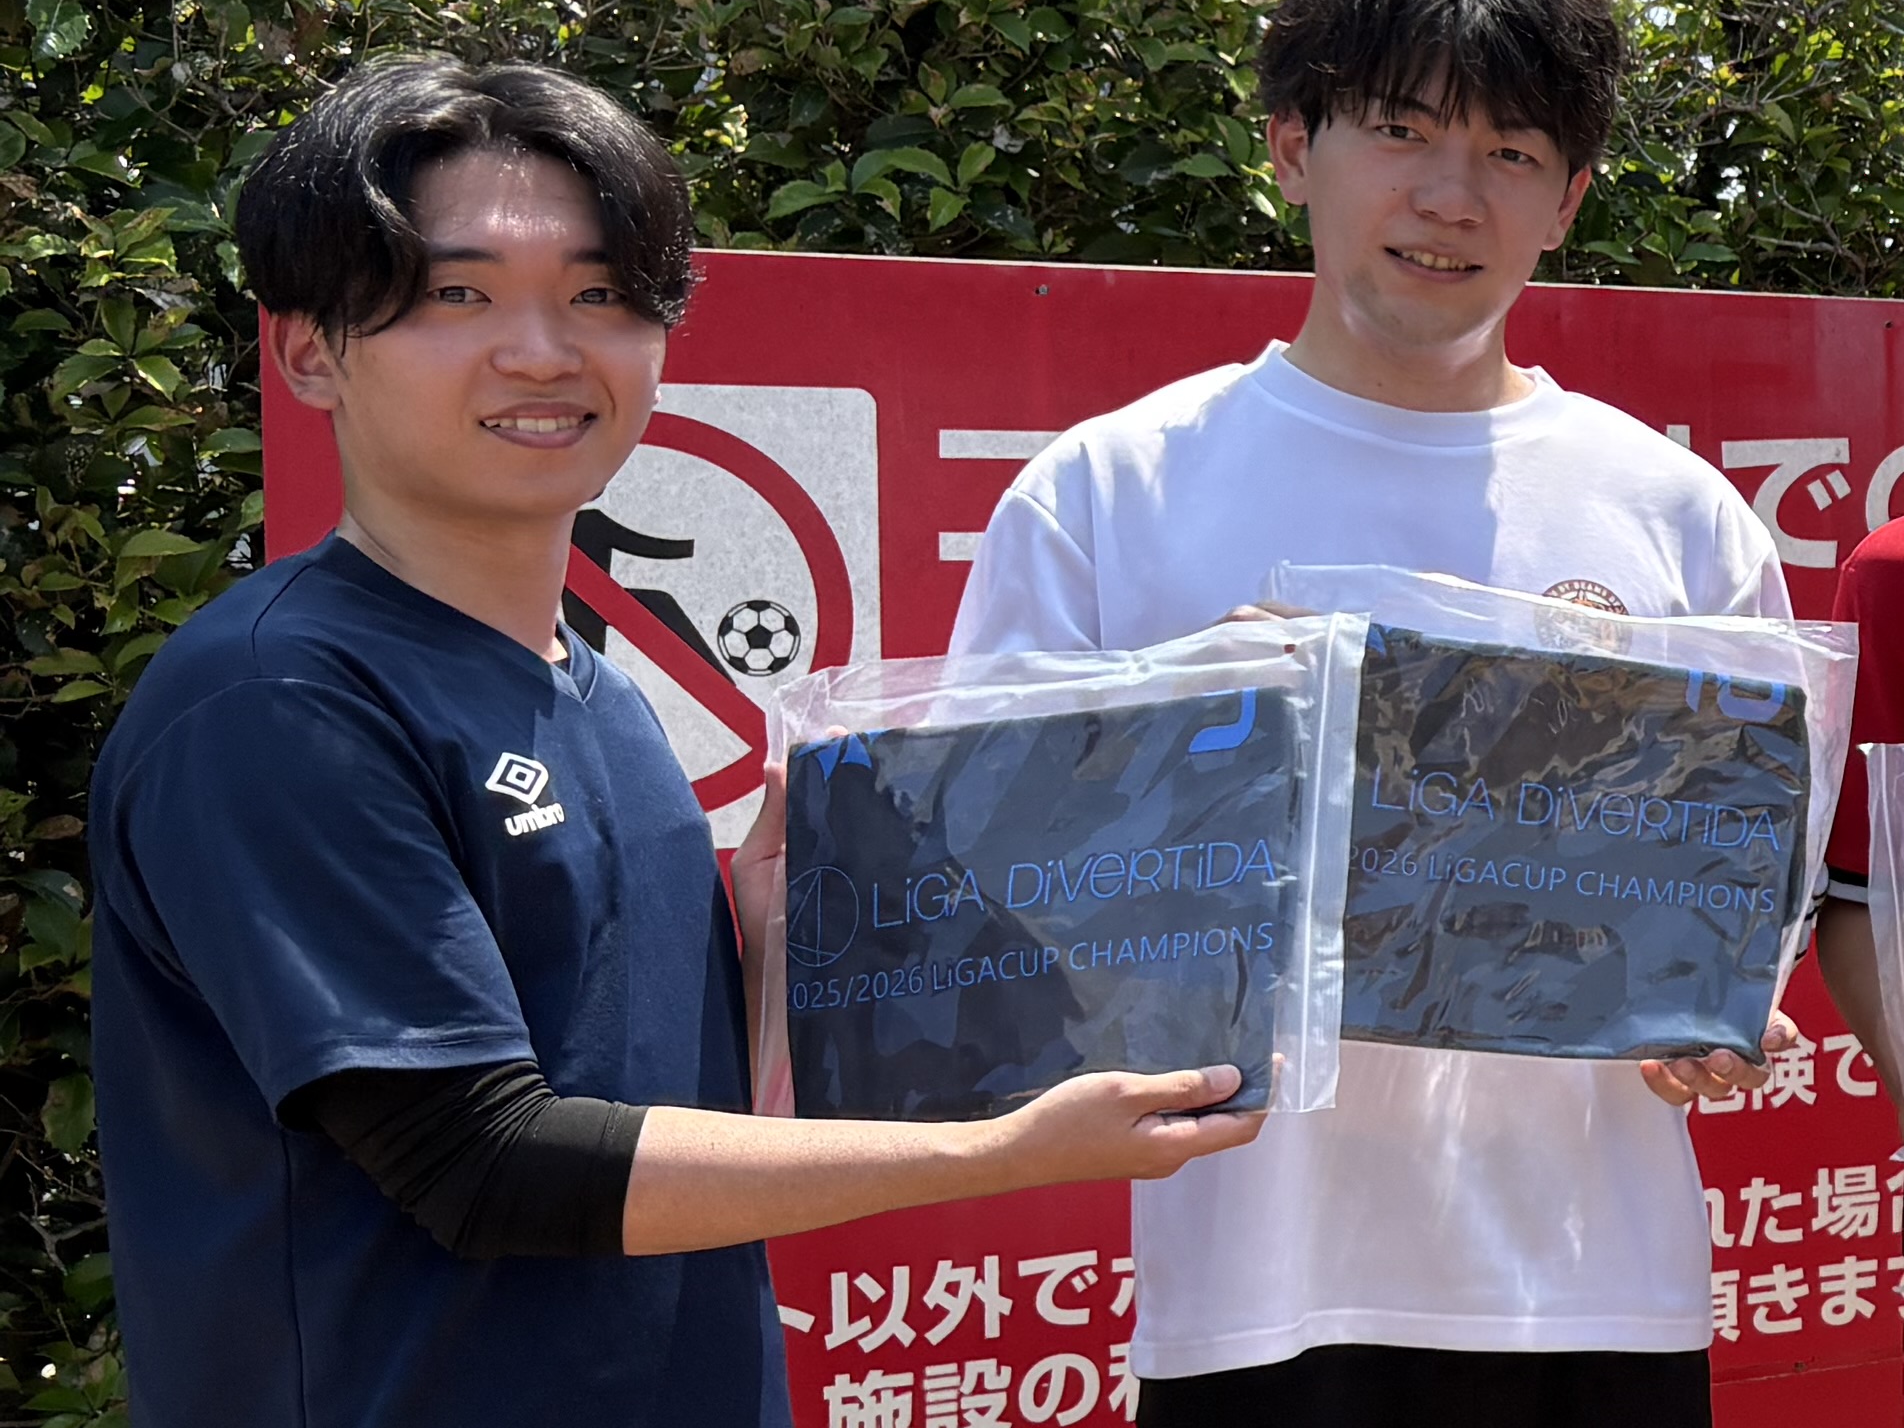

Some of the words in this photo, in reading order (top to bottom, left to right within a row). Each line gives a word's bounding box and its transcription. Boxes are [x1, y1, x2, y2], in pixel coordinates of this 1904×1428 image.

[505, 803, 565, 836] umbro
[1576, 873, 1775, 912] CHAMPIONS
[1068, 923, 1274, 970] CHAMPIONS
